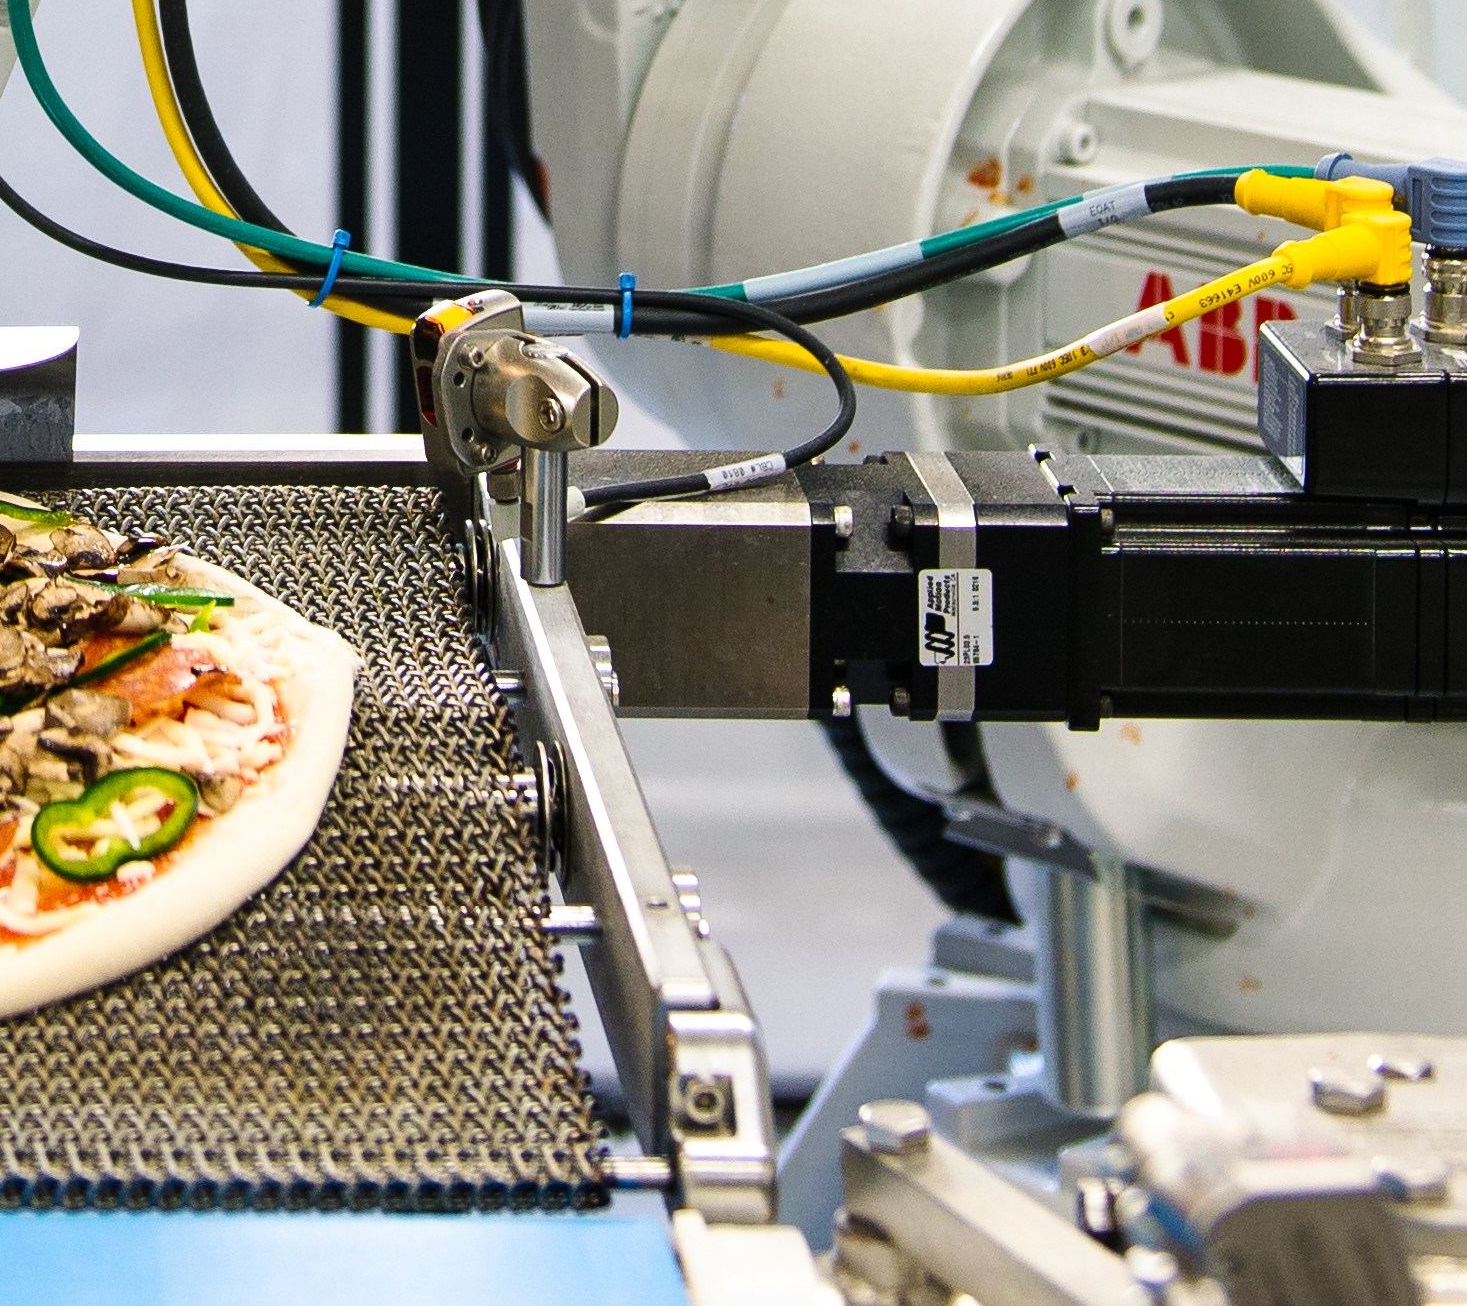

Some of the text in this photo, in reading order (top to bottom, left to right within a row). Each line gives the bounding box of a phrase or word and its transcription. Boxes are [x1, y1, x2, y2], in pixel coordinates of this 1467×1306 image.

[1248, 269, 1276, 288] 600V
[1198, 283, 1242, 309] E41663
[942, 574, 951, 614] Products
